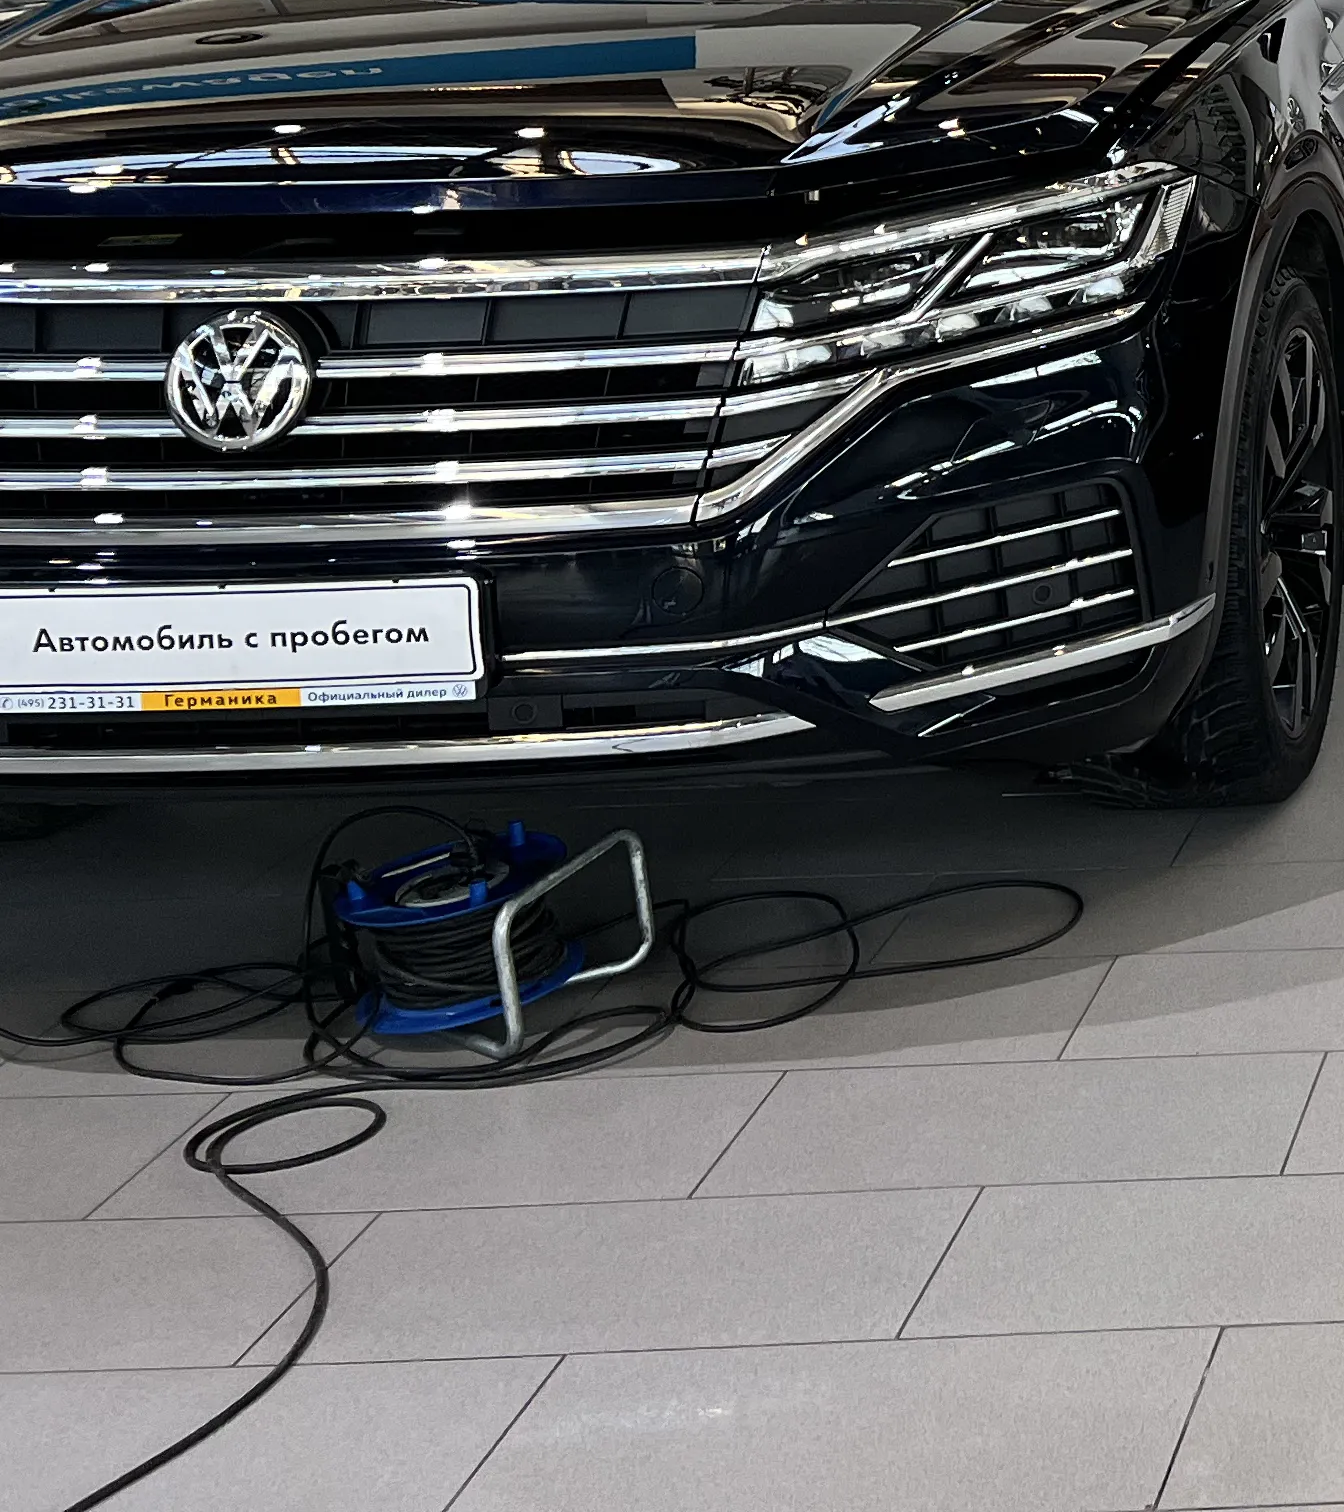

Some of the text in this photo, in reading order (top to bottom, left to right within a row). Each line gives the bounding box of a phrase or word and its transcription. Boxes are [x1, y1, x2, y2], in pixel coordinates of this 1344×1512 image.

[32, 619, 430, 653] Автомобиль с пробегом
[17, 697, 45, 709] (495)
[47, 696, 135, 709] 231-31-31
[164, 694, 277, 709] Германика
[308, 688, 404, 703] Официальный
[407, 688, 447, 699] дилер
